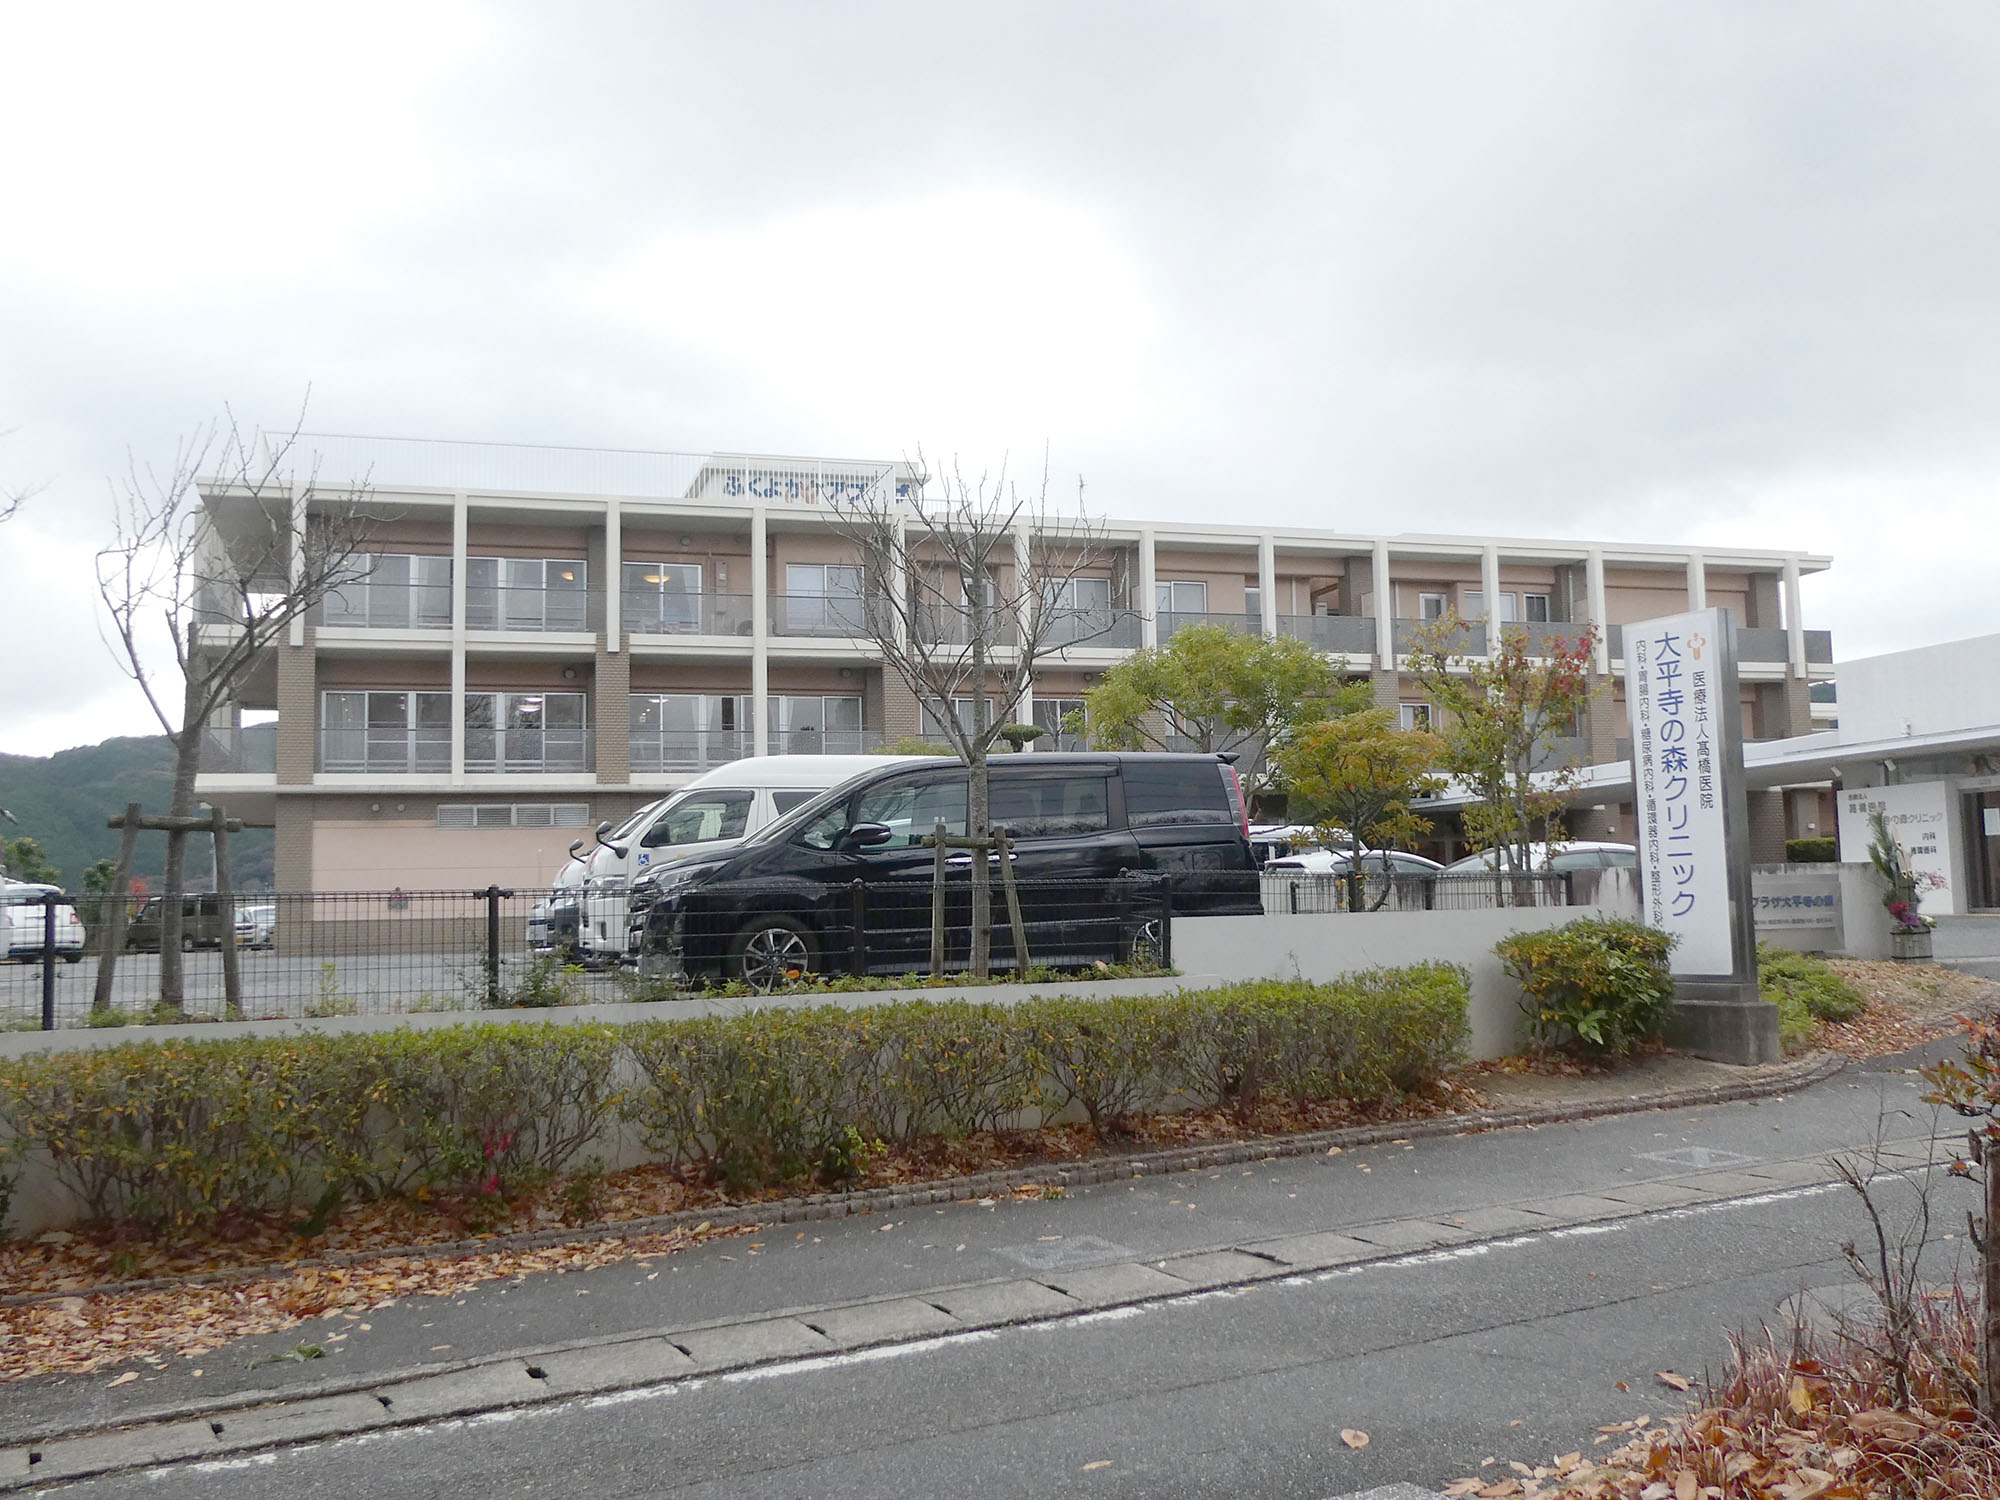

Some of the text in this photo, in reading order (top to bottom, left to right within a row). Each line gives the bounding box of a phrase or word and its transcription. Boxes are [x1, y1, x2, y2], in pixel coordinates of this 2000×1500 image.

[1654, 631, 1695, 917] 大平寺の森クリニック
